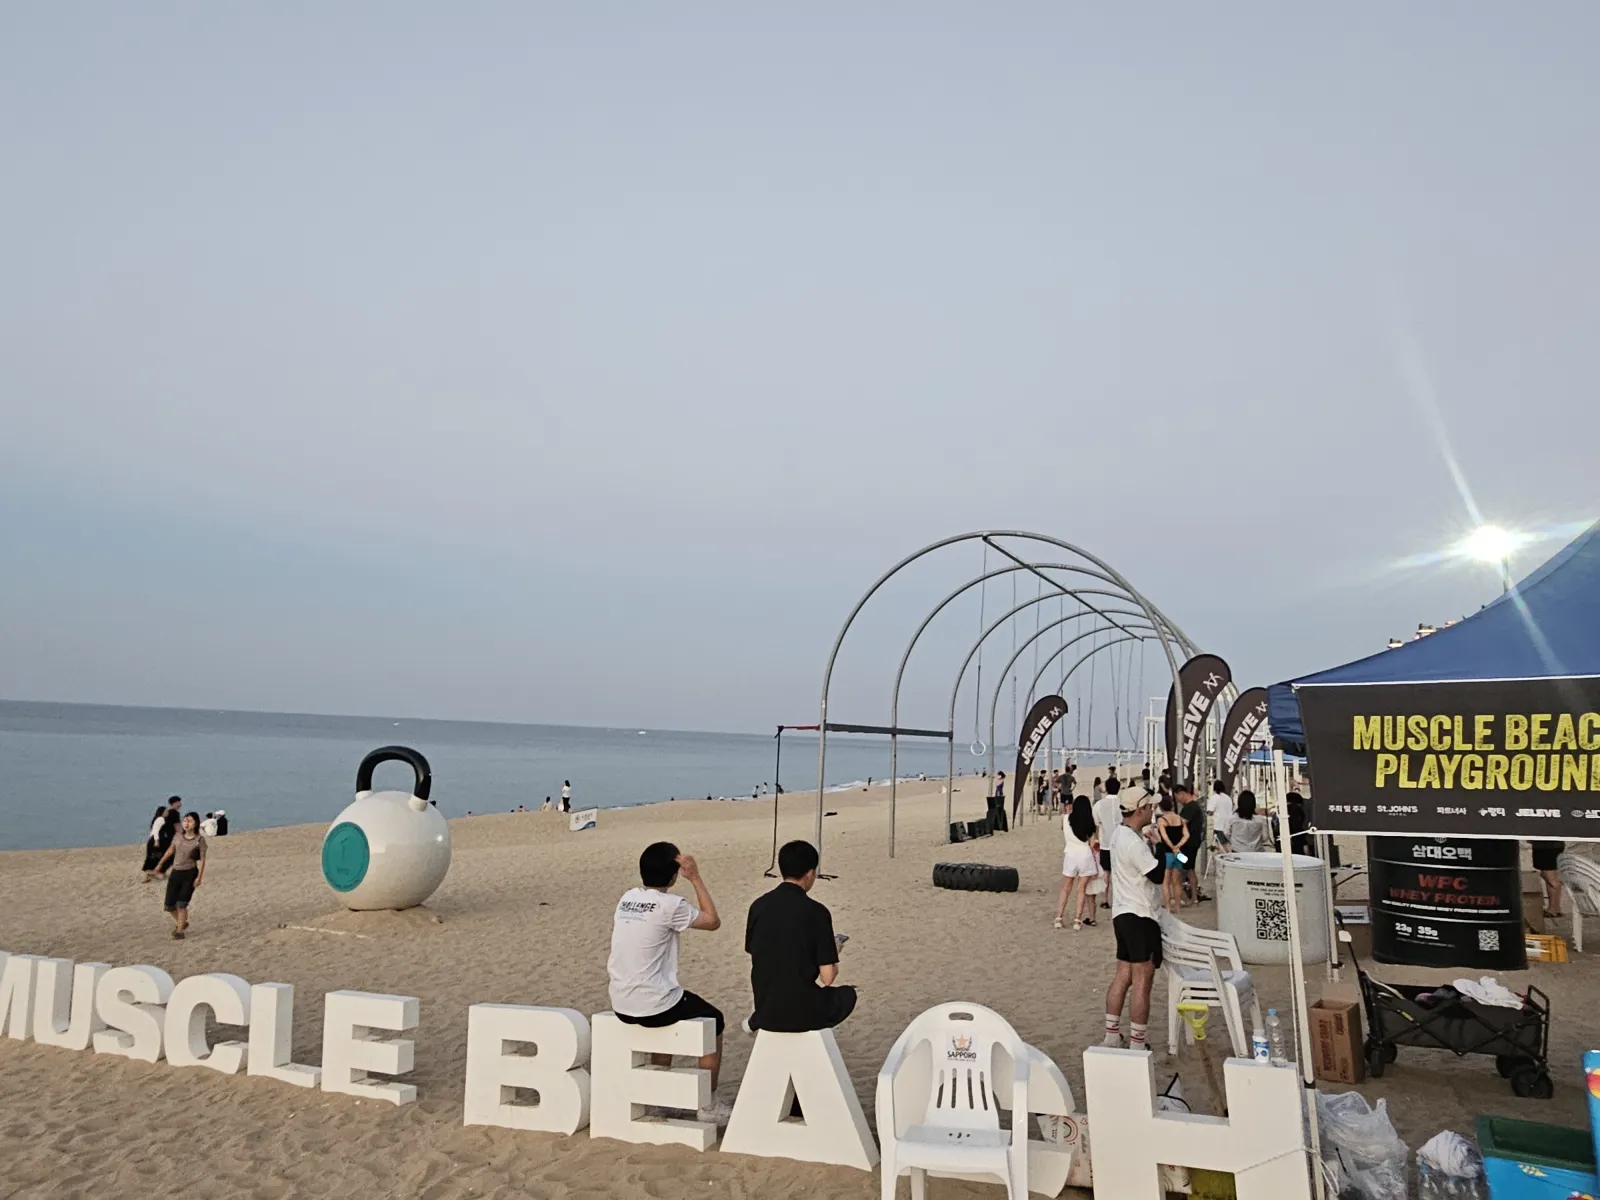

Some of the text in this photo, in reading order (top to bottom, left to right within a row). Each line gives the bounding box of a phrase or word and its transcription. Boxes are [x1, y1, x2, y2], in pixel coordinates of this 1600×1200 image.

[1021, 715, 1052, 765] JELEVE
[1353, 714, 1495, 751] MUSCLE
[1223, 712, 1259, 773] JELEVE
[1515, 808, 1561, 817] JELEVE
[1411, 844, 1473, 860] 삼대오백
[1417, 873, 1469, 890] WPC
[1390, 887, 1501, 905] WHEY PROTEIN
[946, 1050, 977, 1060] SAPPORO
